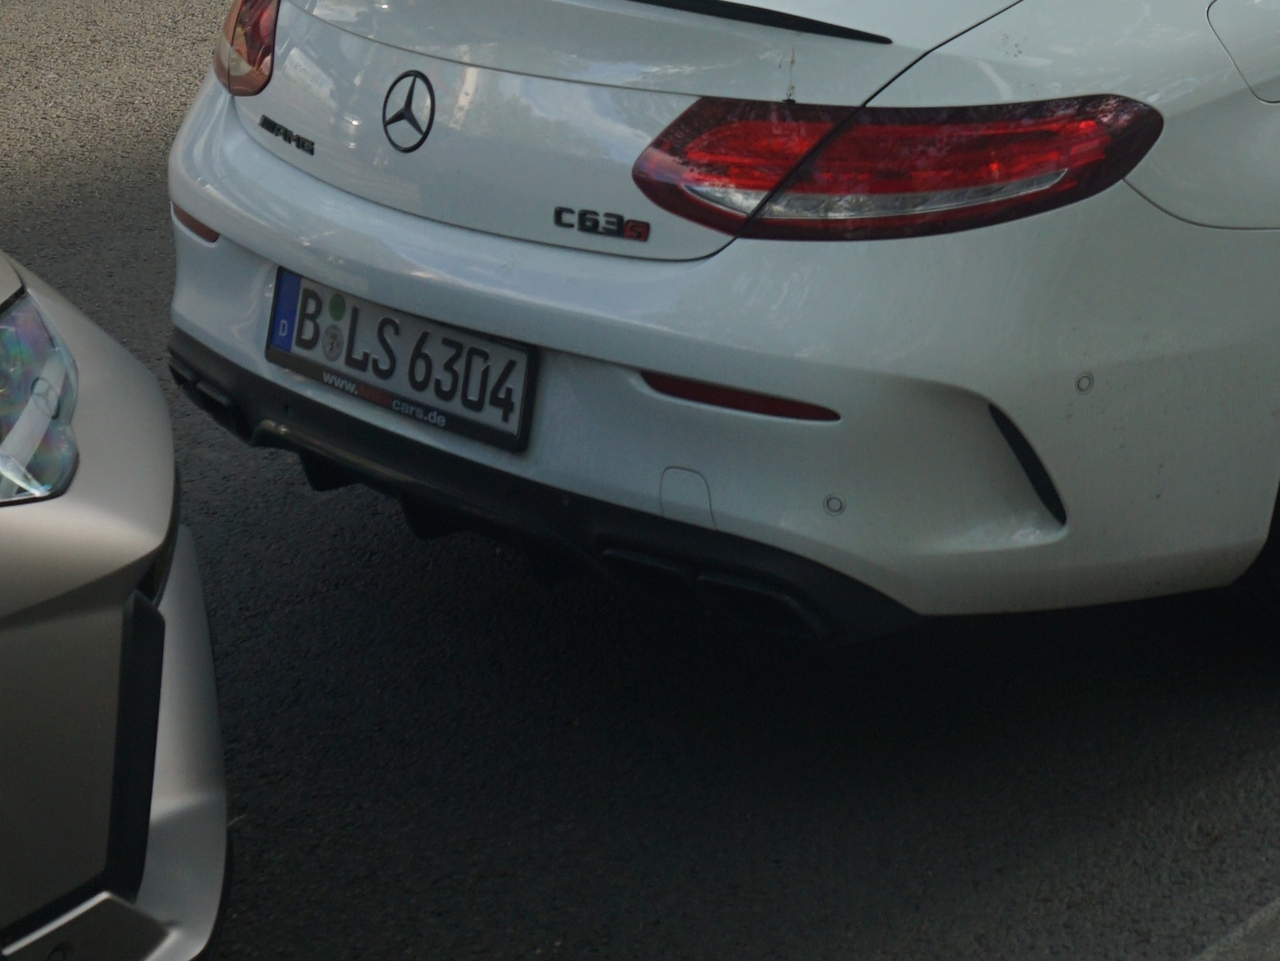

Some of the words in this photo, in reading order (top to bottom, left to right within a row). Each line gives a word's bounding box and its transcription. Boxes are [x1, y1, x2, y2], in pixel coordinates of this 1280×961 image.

[278, 319, 288, 337] D
[295, 287, 322, 350] B
[344, 304, 401, 380] LS
[408, 330, 518, 424] 6304
